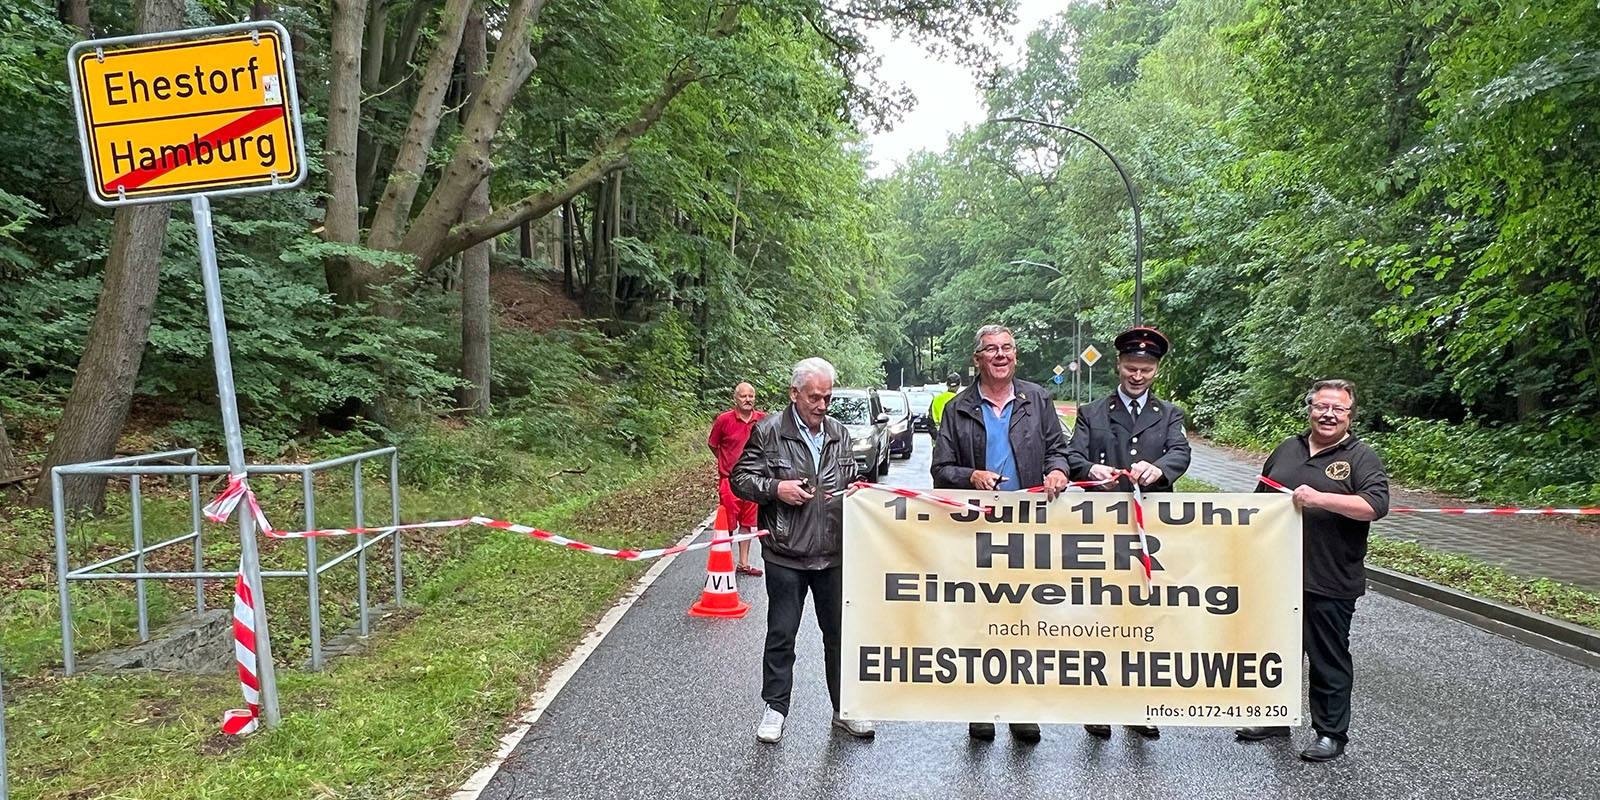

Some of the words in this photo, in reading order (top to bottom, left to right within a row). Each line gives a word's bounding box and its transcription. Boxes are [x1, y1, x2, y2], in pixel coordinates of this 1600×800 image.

[104, 57, 259, 106] Ehestorf
[110, 133, 276, 174] Hamburg
[884, 496, 930, 521] 1.
[949, 499, 1047, 524] Juli
[1071, 500, 1129, 525] 11
[1158, 501, 1260, 526] Uhr
[975, 532, 1165, 571] HIER
[884, 572, 1240, 615] Einweihung
[987, 619, 1030, 638] nach
[1037, 620, 1155, 642] Renovierung
[858, 645, 1109, 687] EHESTORFER
[1121, 650, 1283, 689] HEUWEG
[1146, 704, 1185, 717] Infos:
[1188, 705, 1242, 718] 0172-41
[1246, 705, 1261, 718] 98
[1265, 705, 1288, 718] 250
